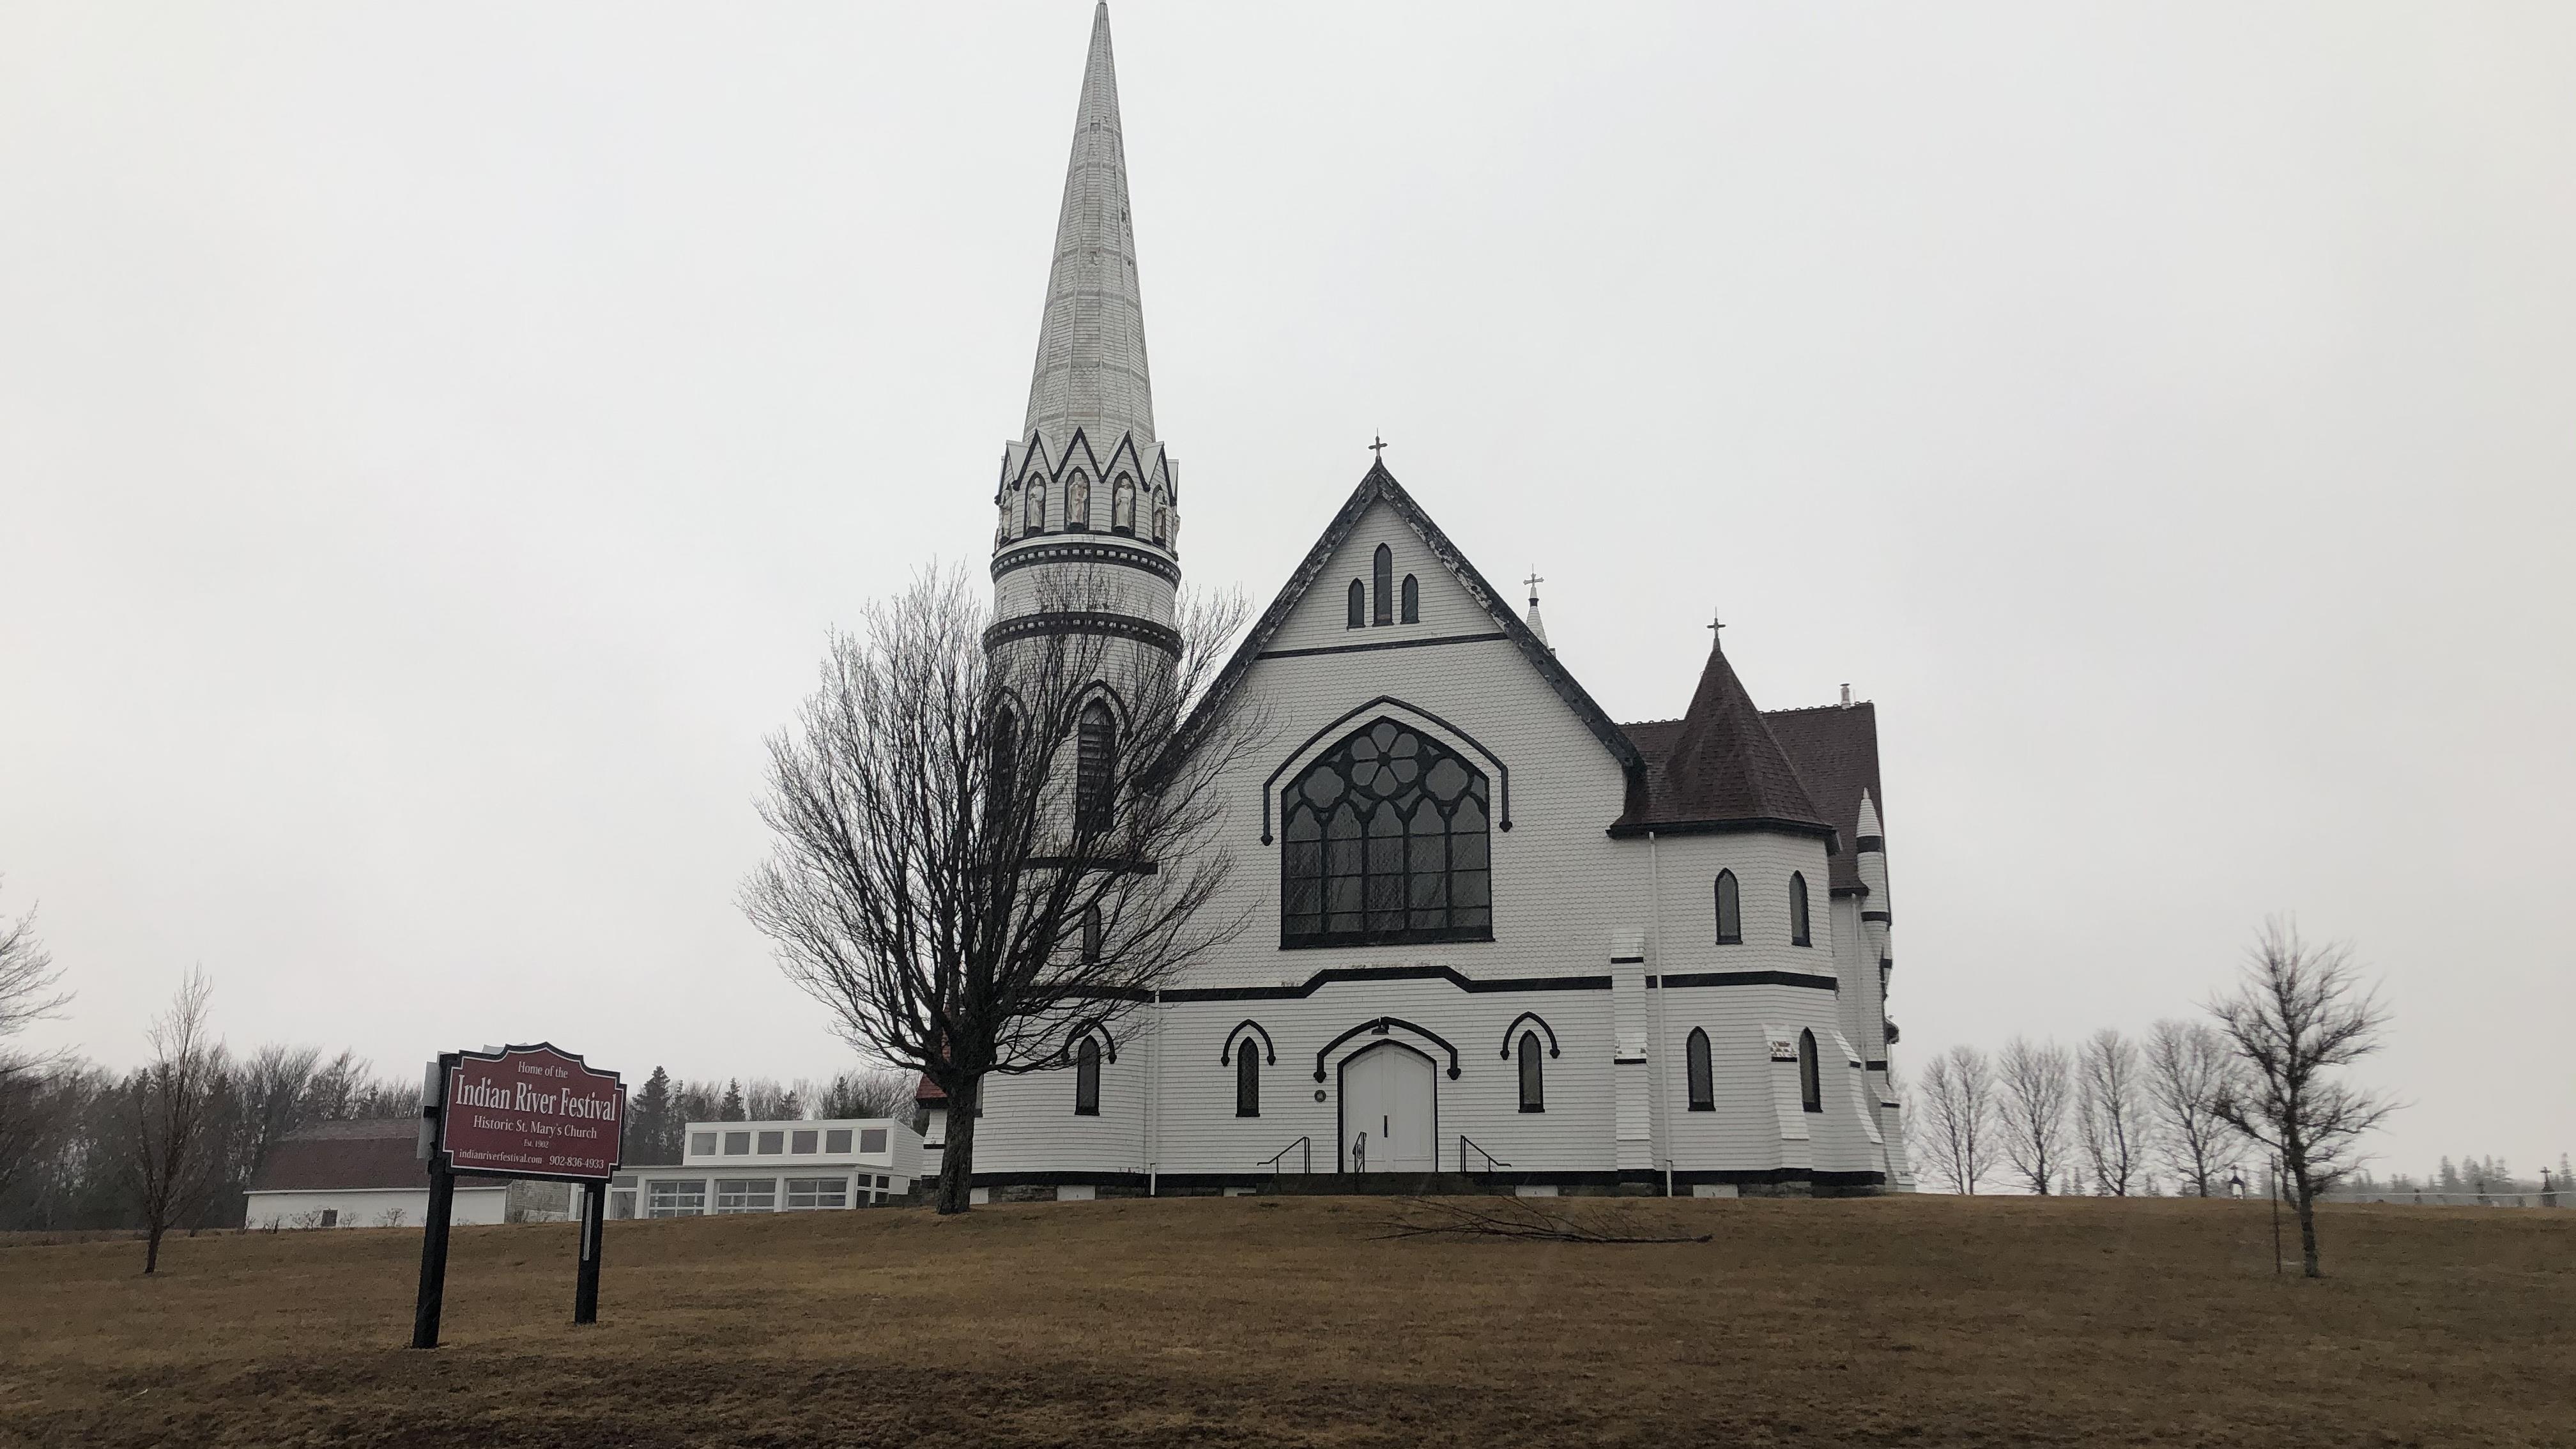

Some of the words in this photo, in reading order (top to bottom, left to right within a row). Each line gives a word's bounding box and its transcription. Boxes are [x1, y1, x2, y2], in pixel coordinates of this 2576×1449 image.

[518, 1061, 542, 1075] Home
[544, 1065, 556, 1077] of
[556, 1066, 568, 1078] the
[456, 1075, 510, 1110] Indian
[514, 1082, 556, 1114] River
[560, 1087, 616, 1121] Festival
[473, 1115, 514, 1131] Historic
[531, 1121, 562, 1138] Mary's
[564, 1124, 598, 1139] Church
[535, 1140, 549, 1149] 1902
[459, 1149, 542, 1164] indianriverfestival.com
[549, 1155, 604, 1169] 902-836-4933
